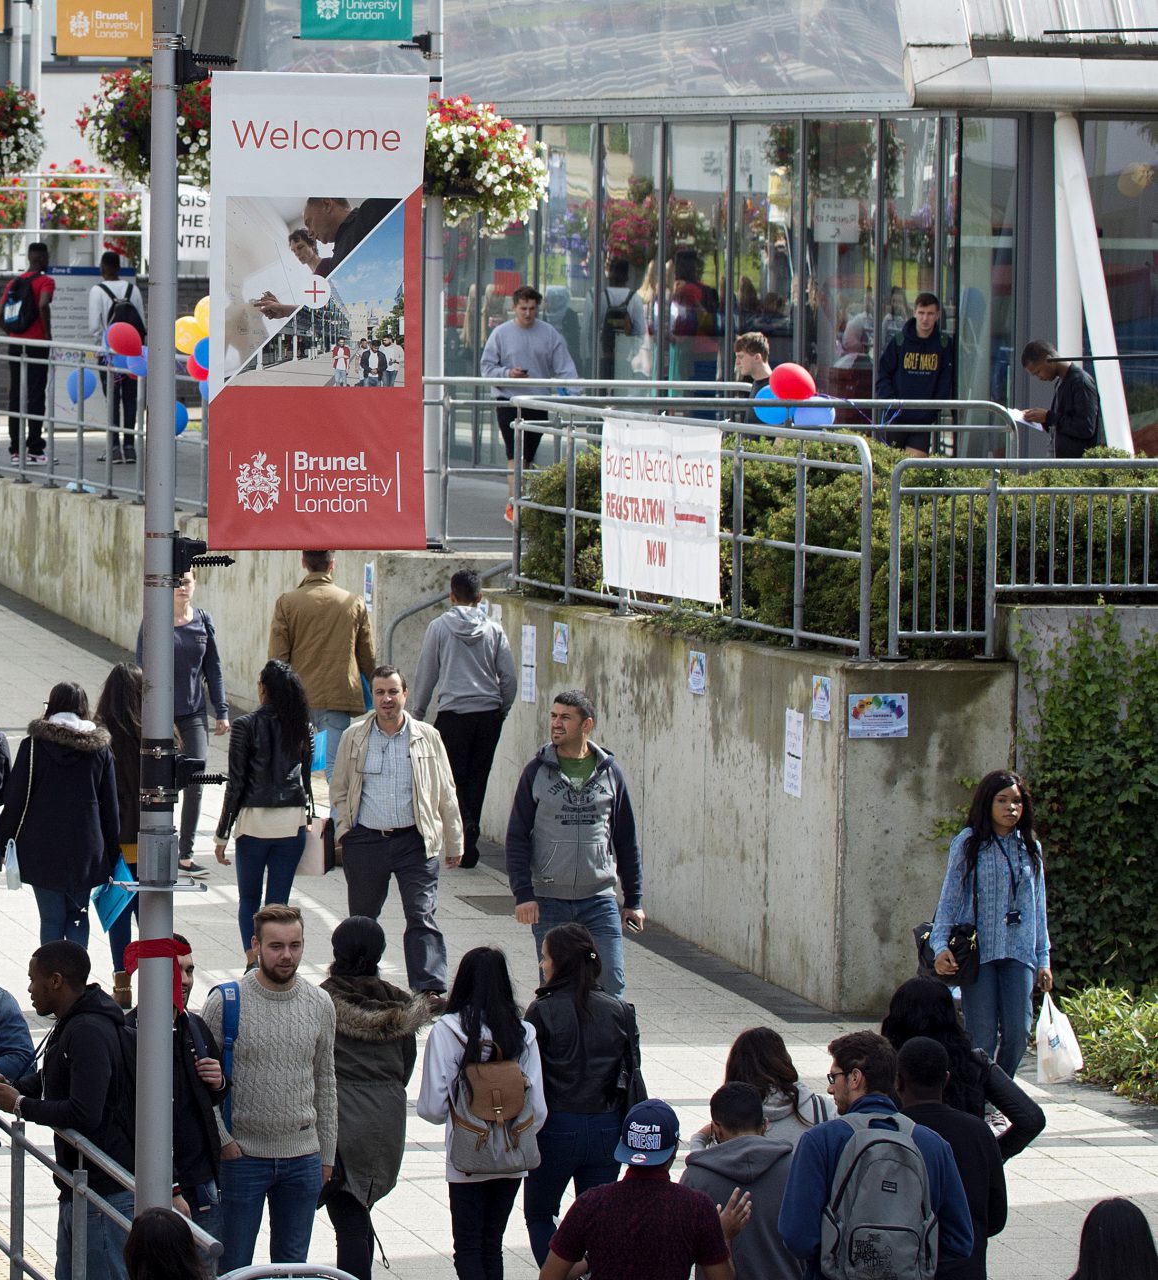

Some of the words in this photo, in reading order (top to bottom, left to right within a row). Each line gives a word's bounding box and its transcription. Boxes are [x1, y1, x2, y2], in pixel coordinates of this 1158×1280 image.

[95, 10, 128, 20] Brunel
[346, 9, 384, 20] London
[95, 20, 139, 32] University
[95, 29, 128, 39] London
[231, 120, 401, 152] Welcome
[904, 352, 919, 370] GOLF
[294, 452, 367, 471] Brunel
[294, 472, 392, 497] University
[294, 494, 368, 513] London
[646, 540, 667, 567] NOW
[627, 1130, 662, 1150] FRESH
